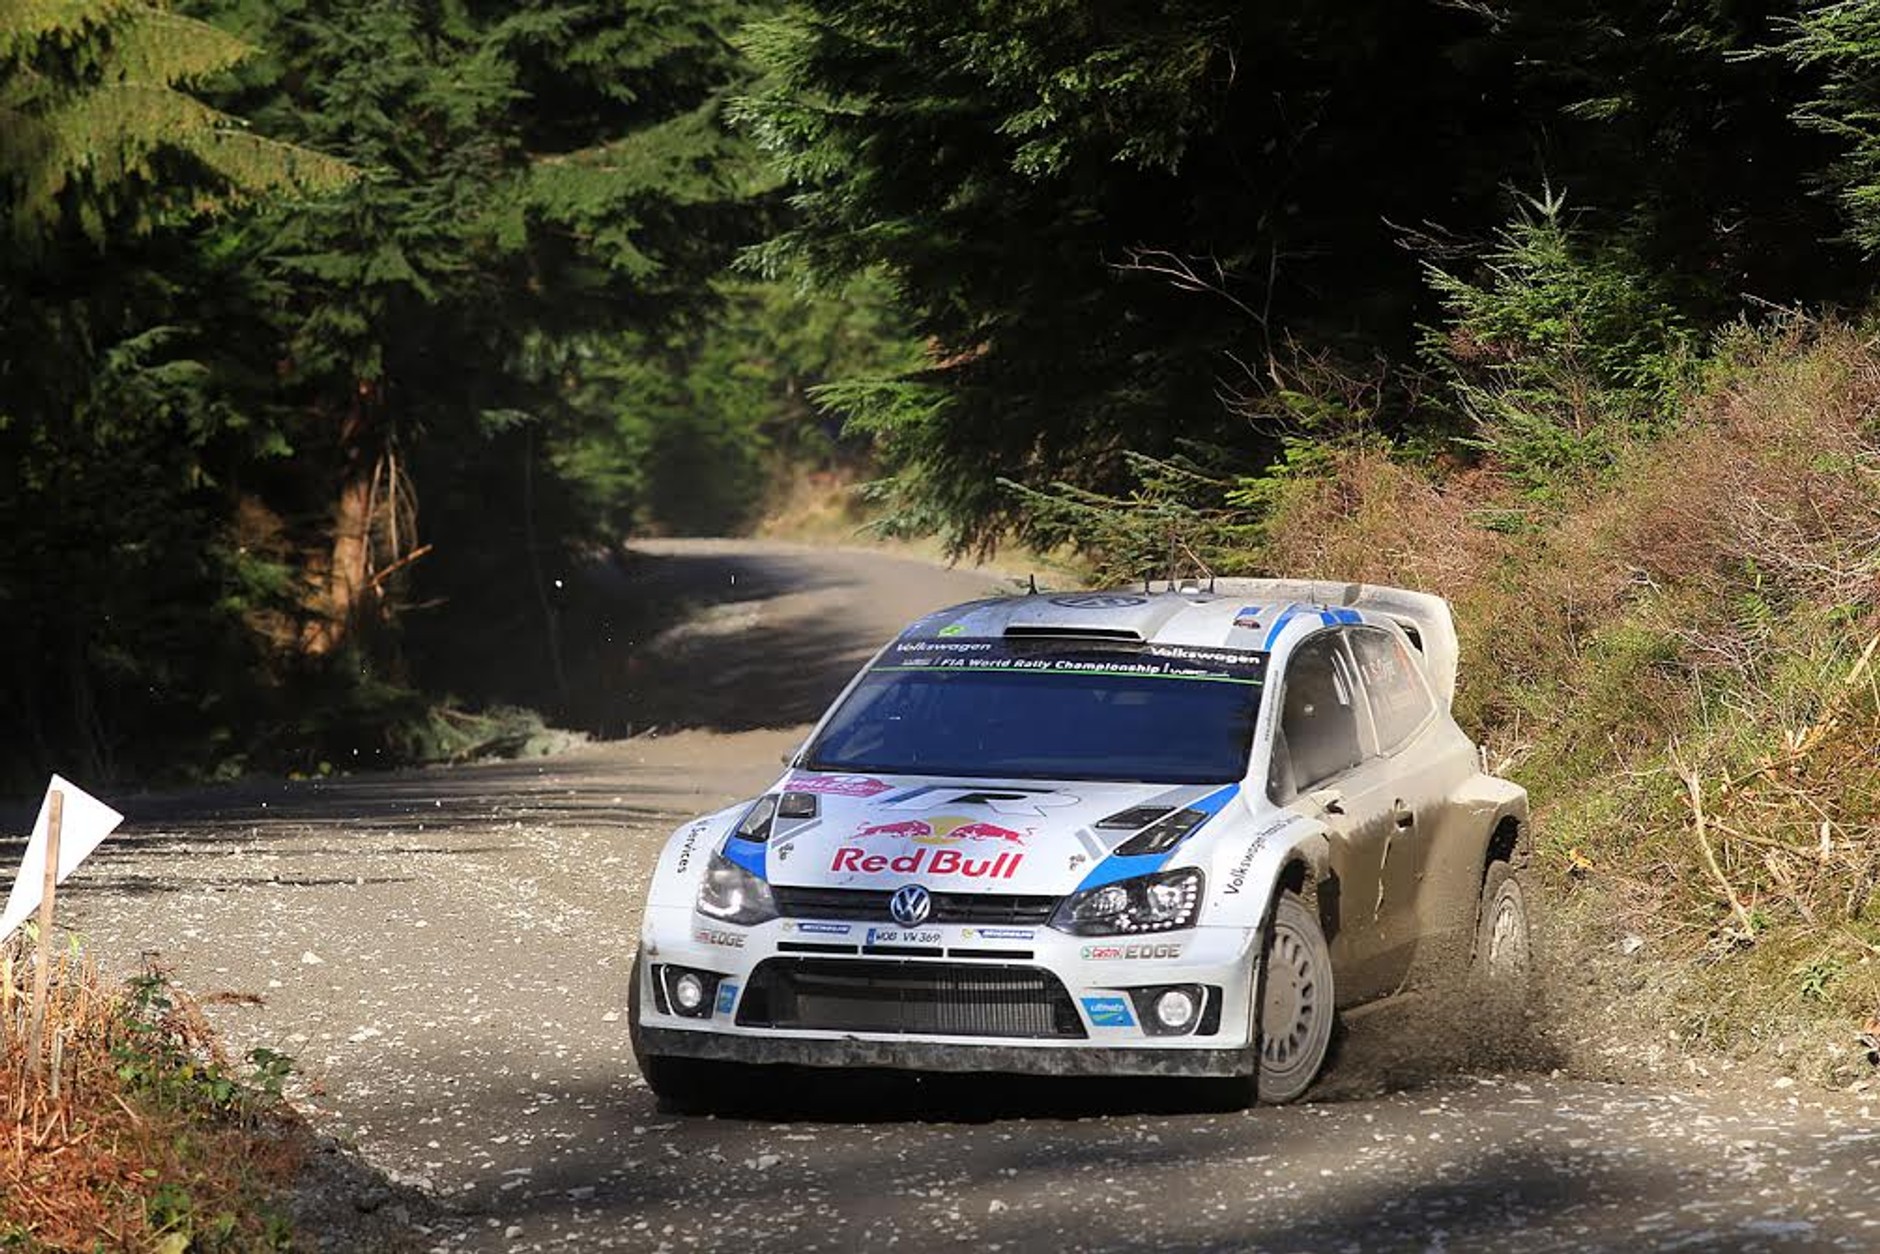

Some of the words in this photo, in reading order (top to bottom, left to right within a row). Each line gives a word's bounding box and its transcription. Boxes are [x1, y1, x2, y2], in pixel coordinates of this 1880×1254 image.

[1151, 647, 1261, 664] Volkswagen
[940, 659, 965, 667] FIA
[968, 659, 1011, 668] World
[1013, 660, 1052, 669] Rally
[1054, 660, 1160, 674] Championship
[831, 848, 927, 873] Red
[927, 849, 1023, 879] Bull
[711, 929, 749, 948] EDGE
[903, 932, 918, 942] VW
[1124, 943, 1183, 960] EDGE
